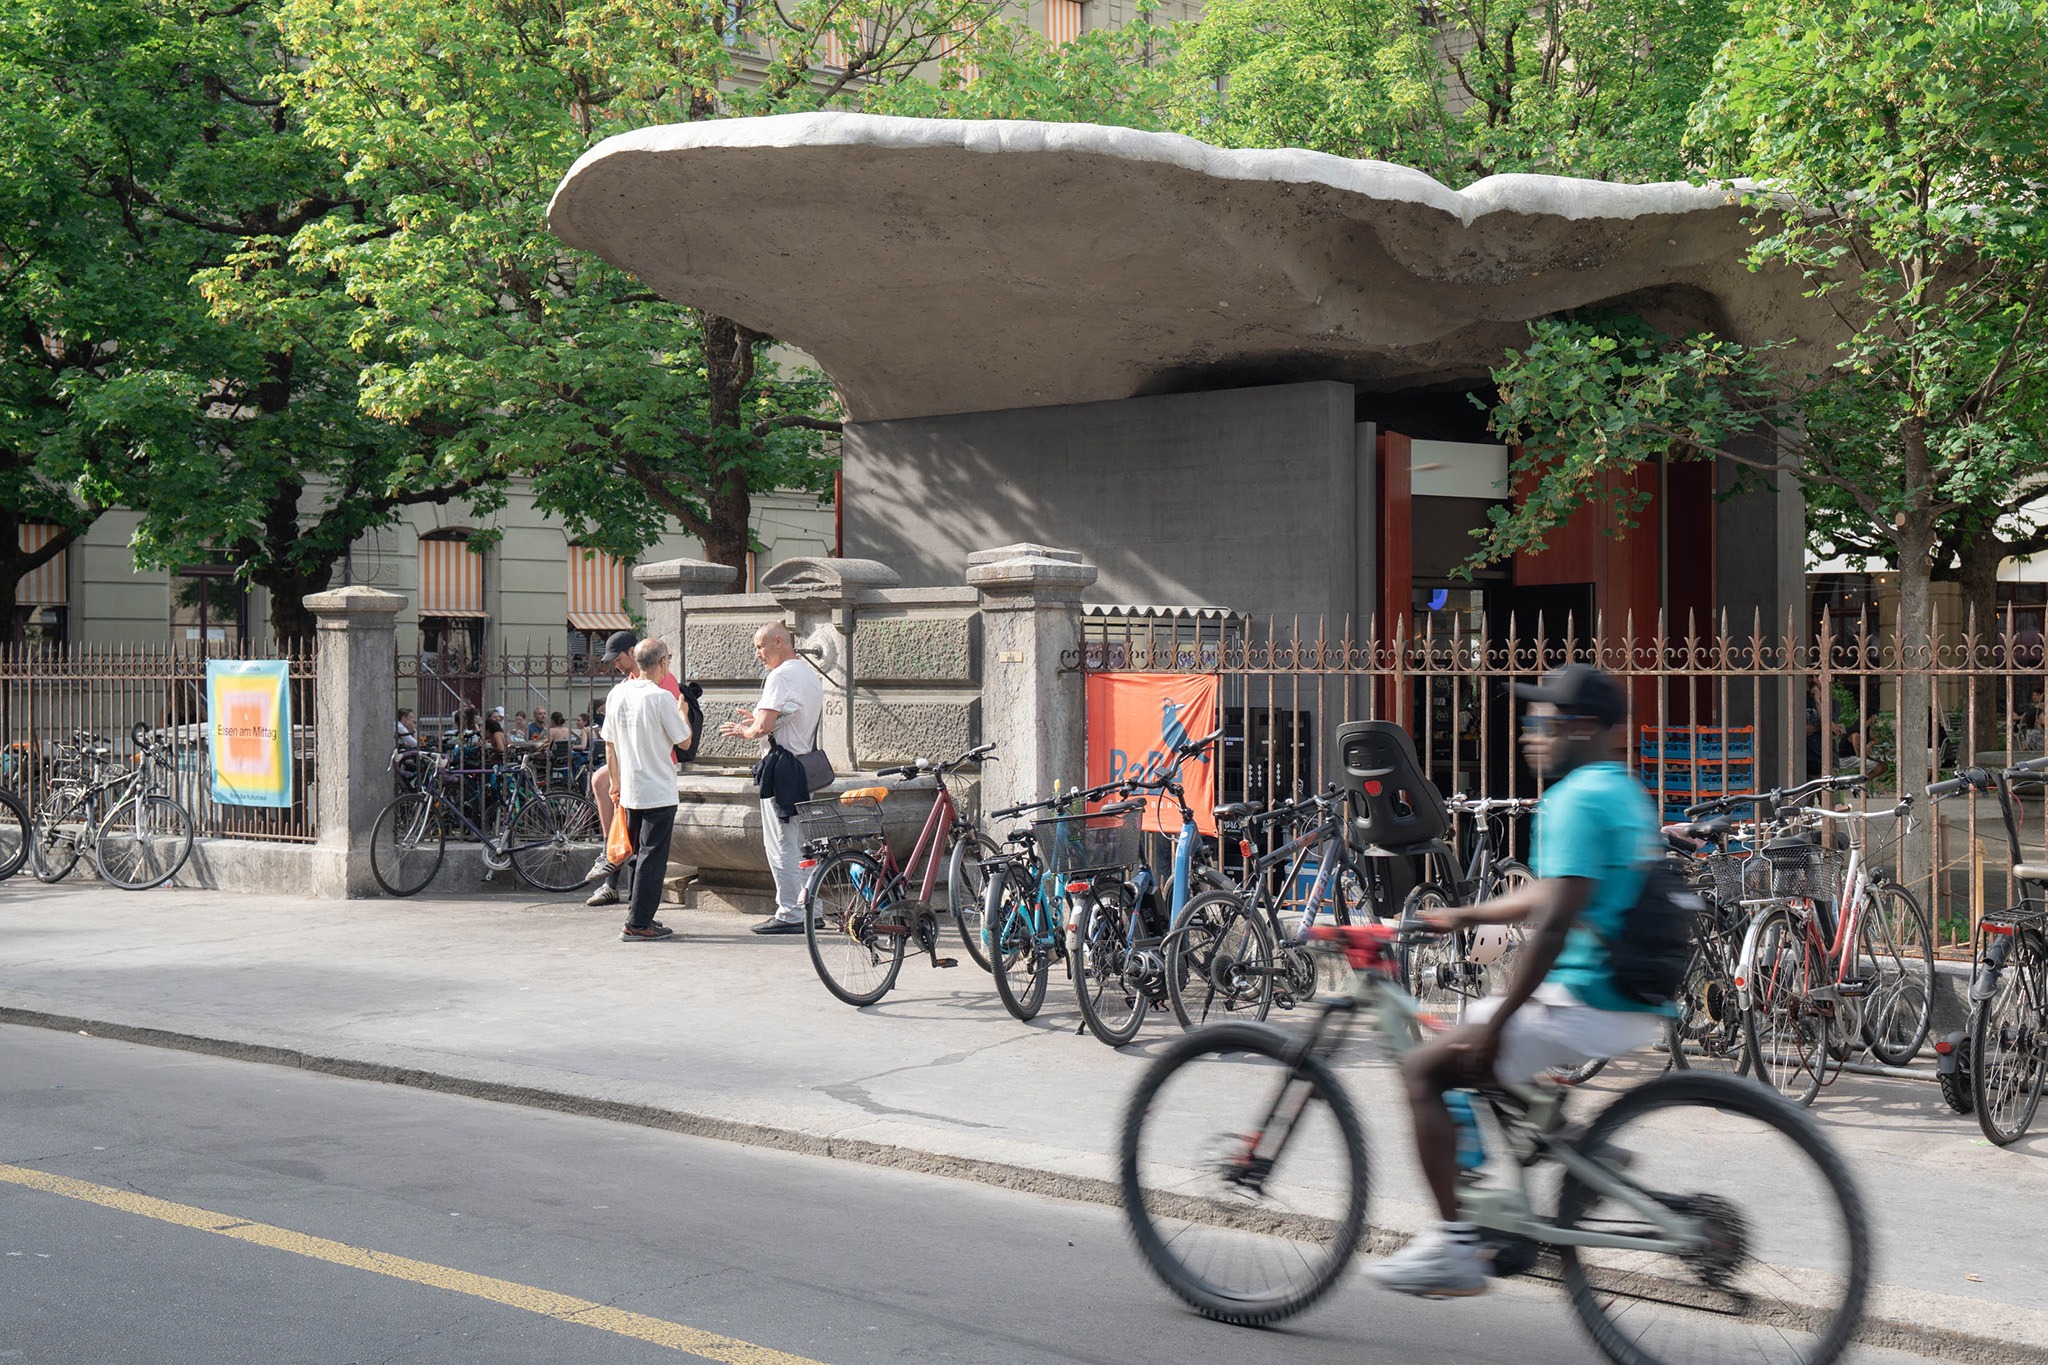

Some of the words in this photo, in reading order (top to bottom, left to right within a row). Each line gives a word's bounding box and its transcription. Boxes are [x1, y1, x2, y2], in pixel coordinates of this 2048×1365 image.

[217, 724, 238, 737] Essen
[239, 727, 251, 737] am
[253, 726, 277, 740] Mittag
